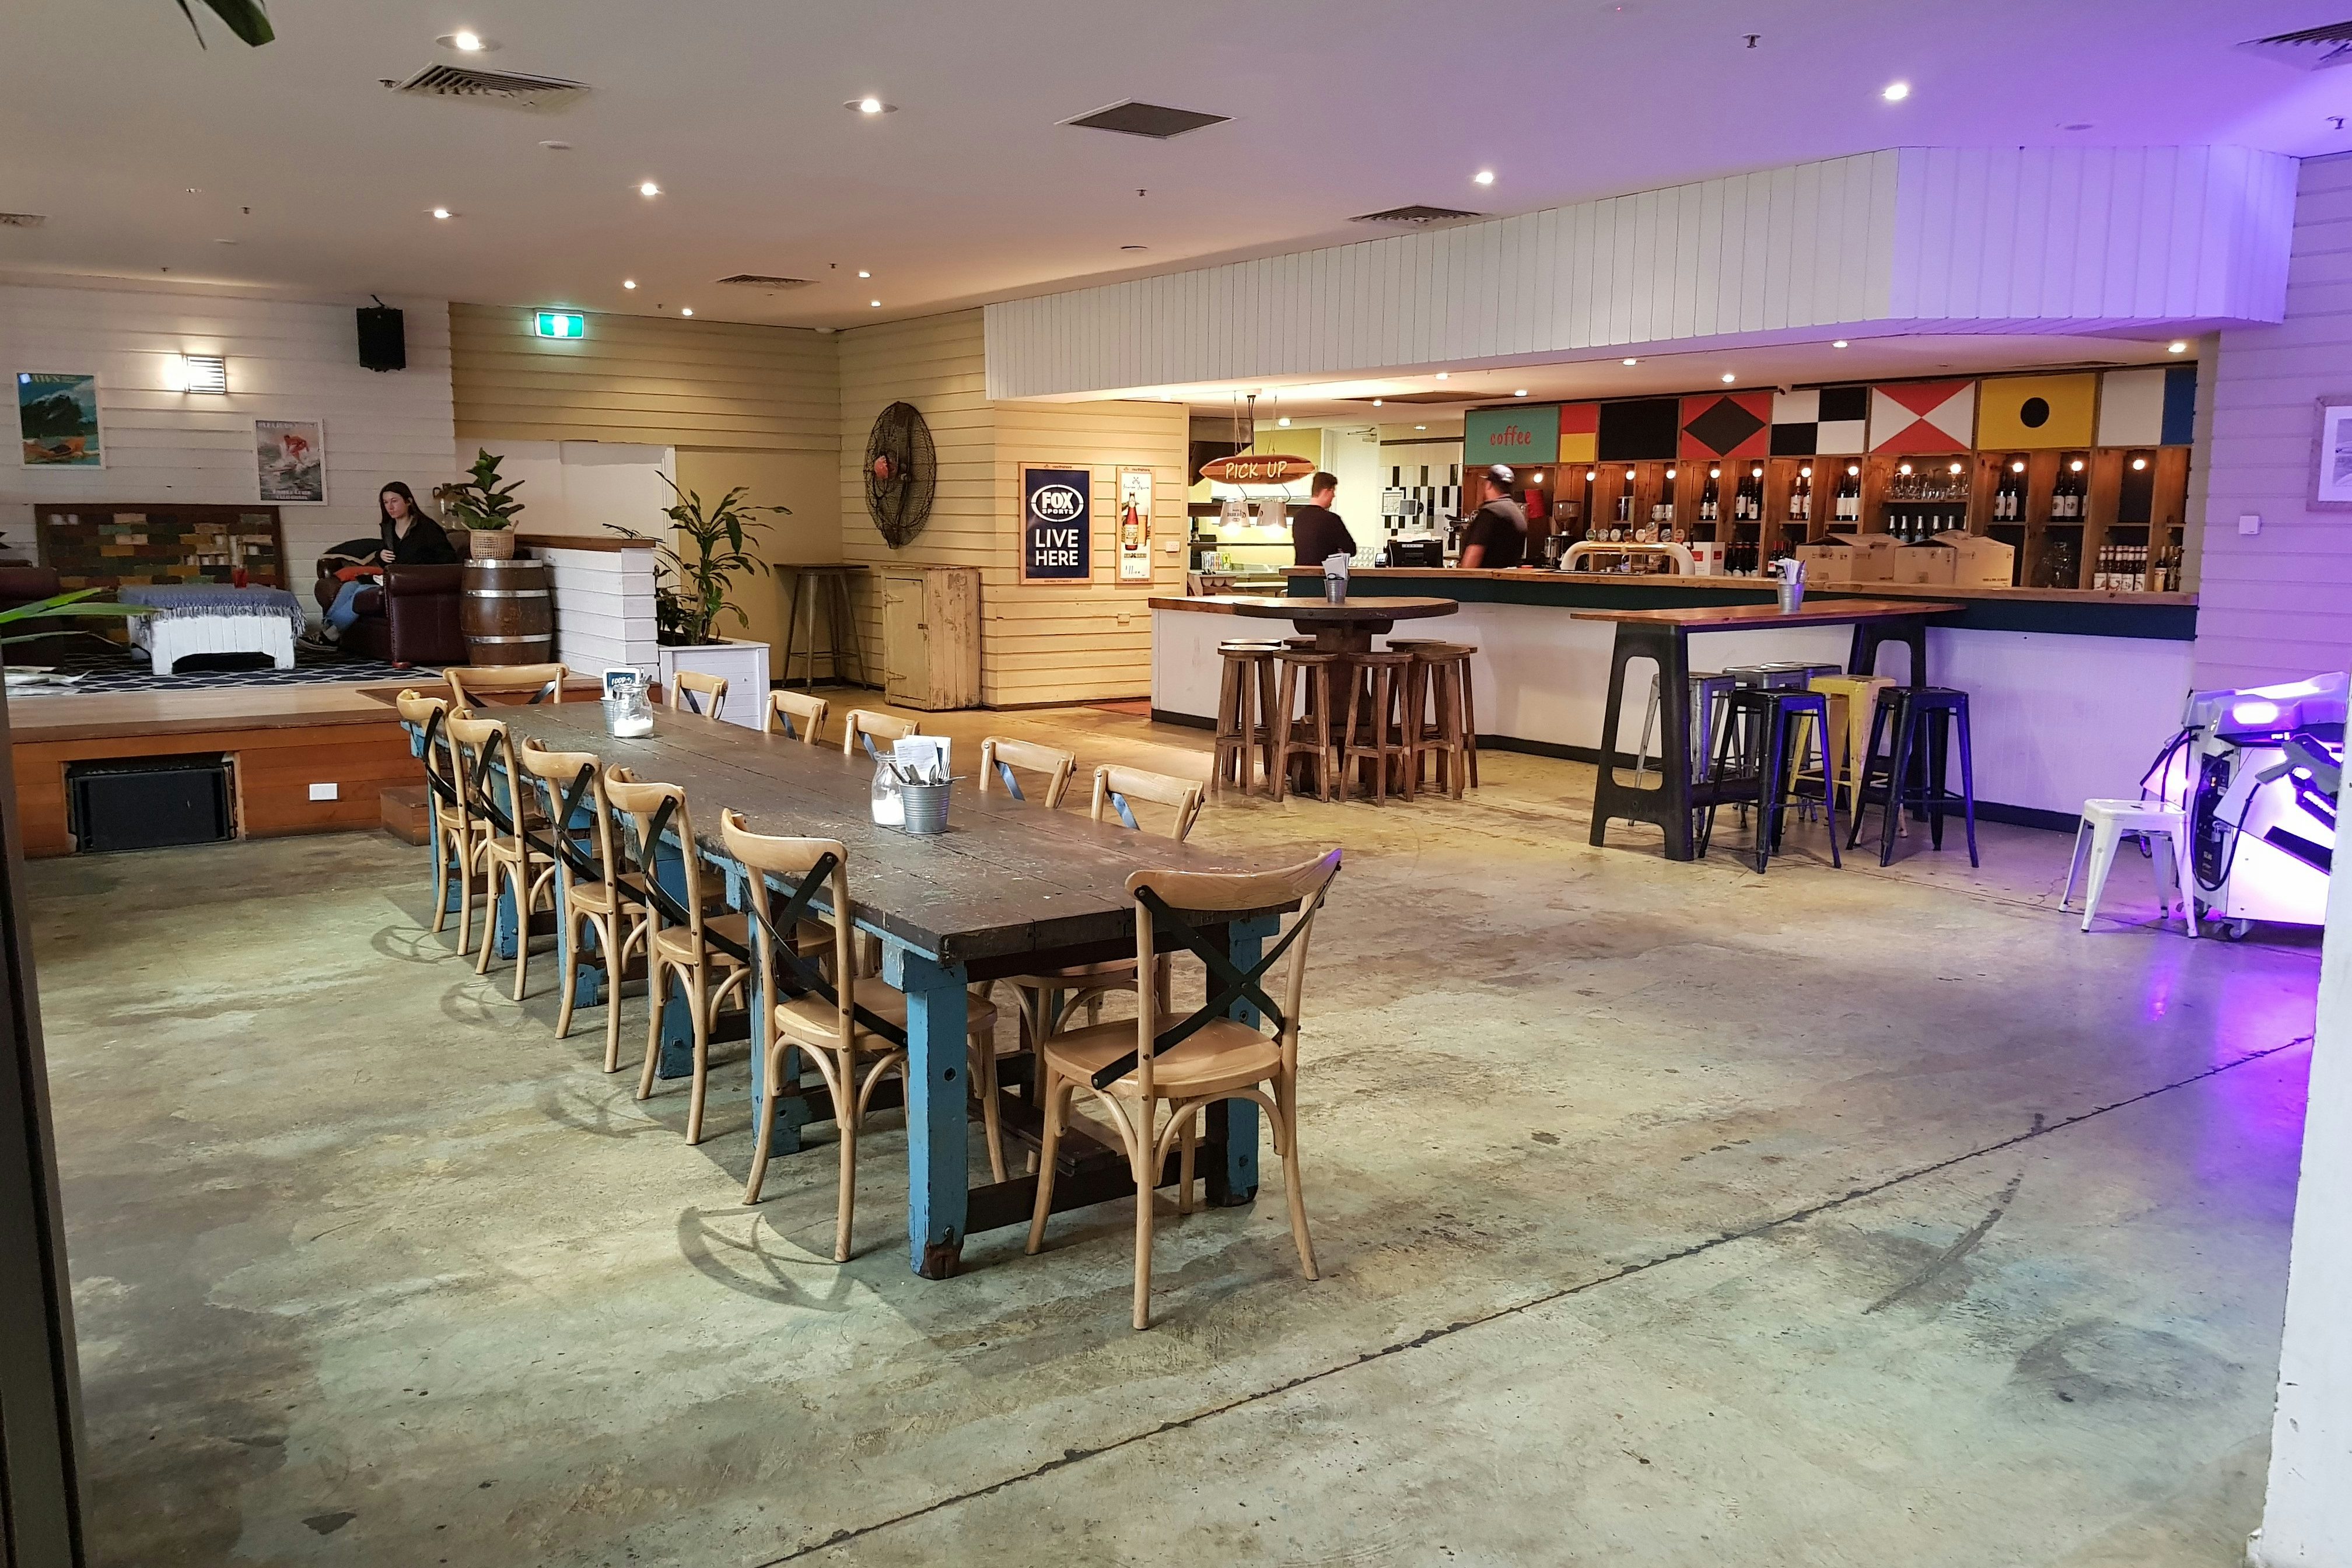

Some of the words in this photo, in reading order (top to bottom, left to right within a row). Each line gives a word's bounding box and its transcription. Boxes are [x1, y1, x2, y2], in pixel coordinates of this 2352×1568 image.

[1490, 425, 1531, 445] coffee
[1226, 462, 1258, 479] PICK
[1267, 461, 1287, 478] UP
[1042, 492, 1074, 509] FOX
[1035, 528, 1079, 548] LIVE
[1035, 550, 1079, 566] HERE
